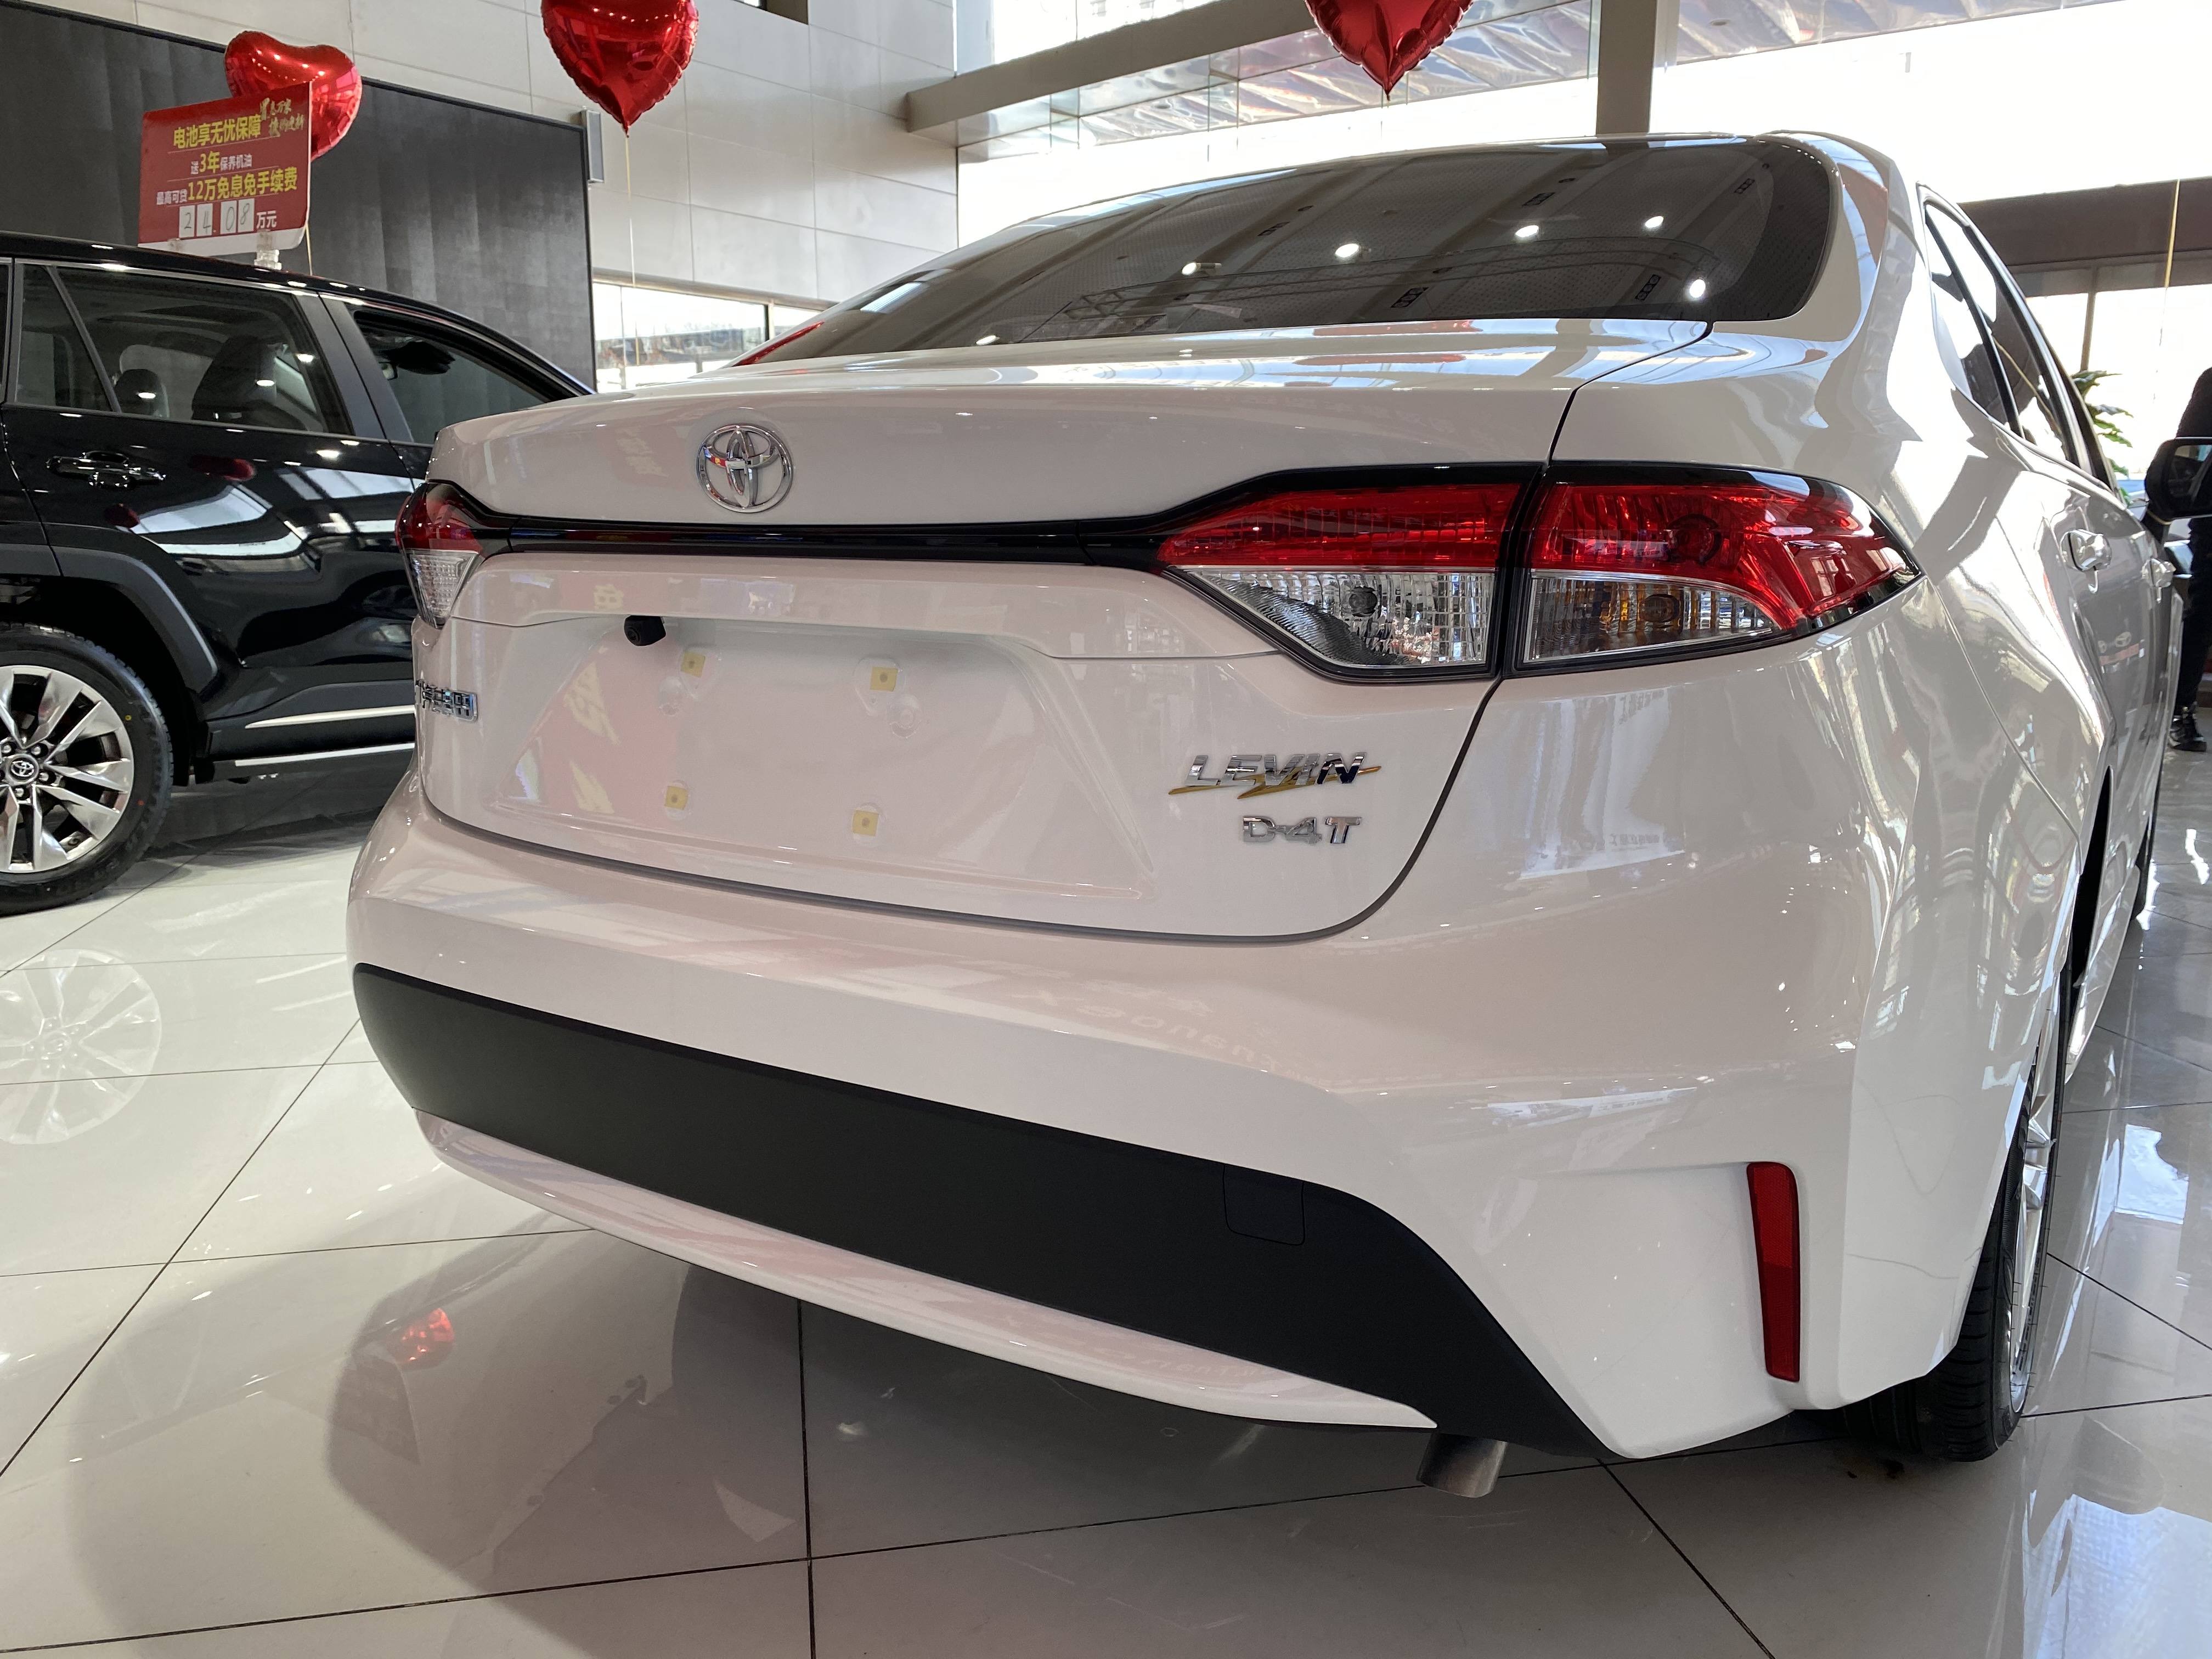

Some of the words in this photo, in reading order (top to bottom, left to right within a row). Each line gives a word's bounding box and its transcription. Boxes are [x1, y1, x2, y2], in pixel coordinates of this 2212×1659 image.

[173, 114, 261, 149] 电池享无忧保障
[191, 151, 252, 174] 送3年保养机油
[1184, 752, 1367, 786] LEVIN
